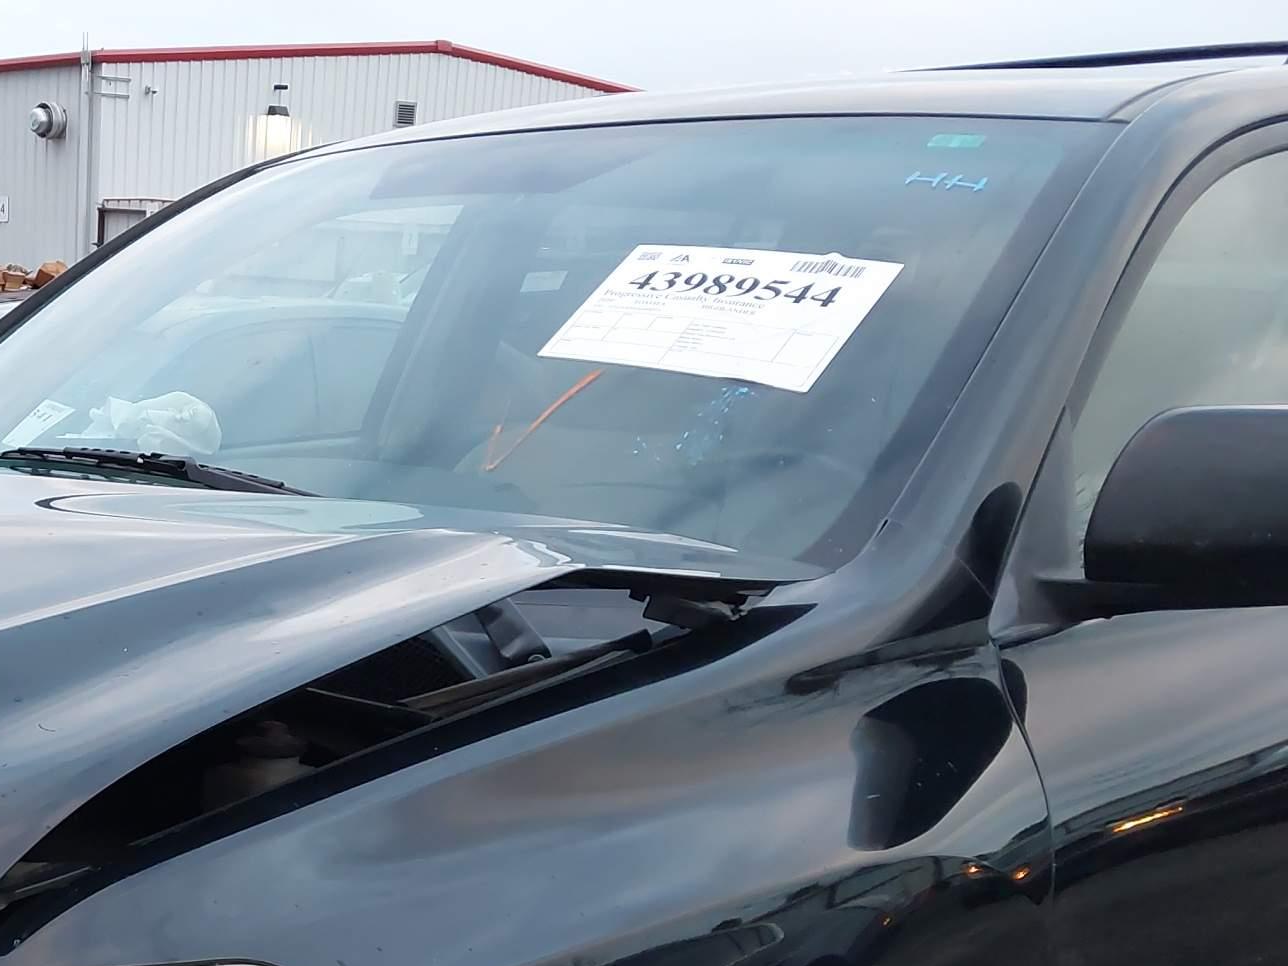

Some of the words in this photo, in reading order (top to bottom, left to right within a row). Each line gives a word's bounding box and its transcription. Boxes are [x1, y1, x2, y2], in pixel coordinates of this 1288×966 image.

[0, 203, 5, 214] 4
[604, 288, 663, 299] Progressive
[713, 297, 766, 309] Insurance
[629, 271, 842, 307] 43989544
